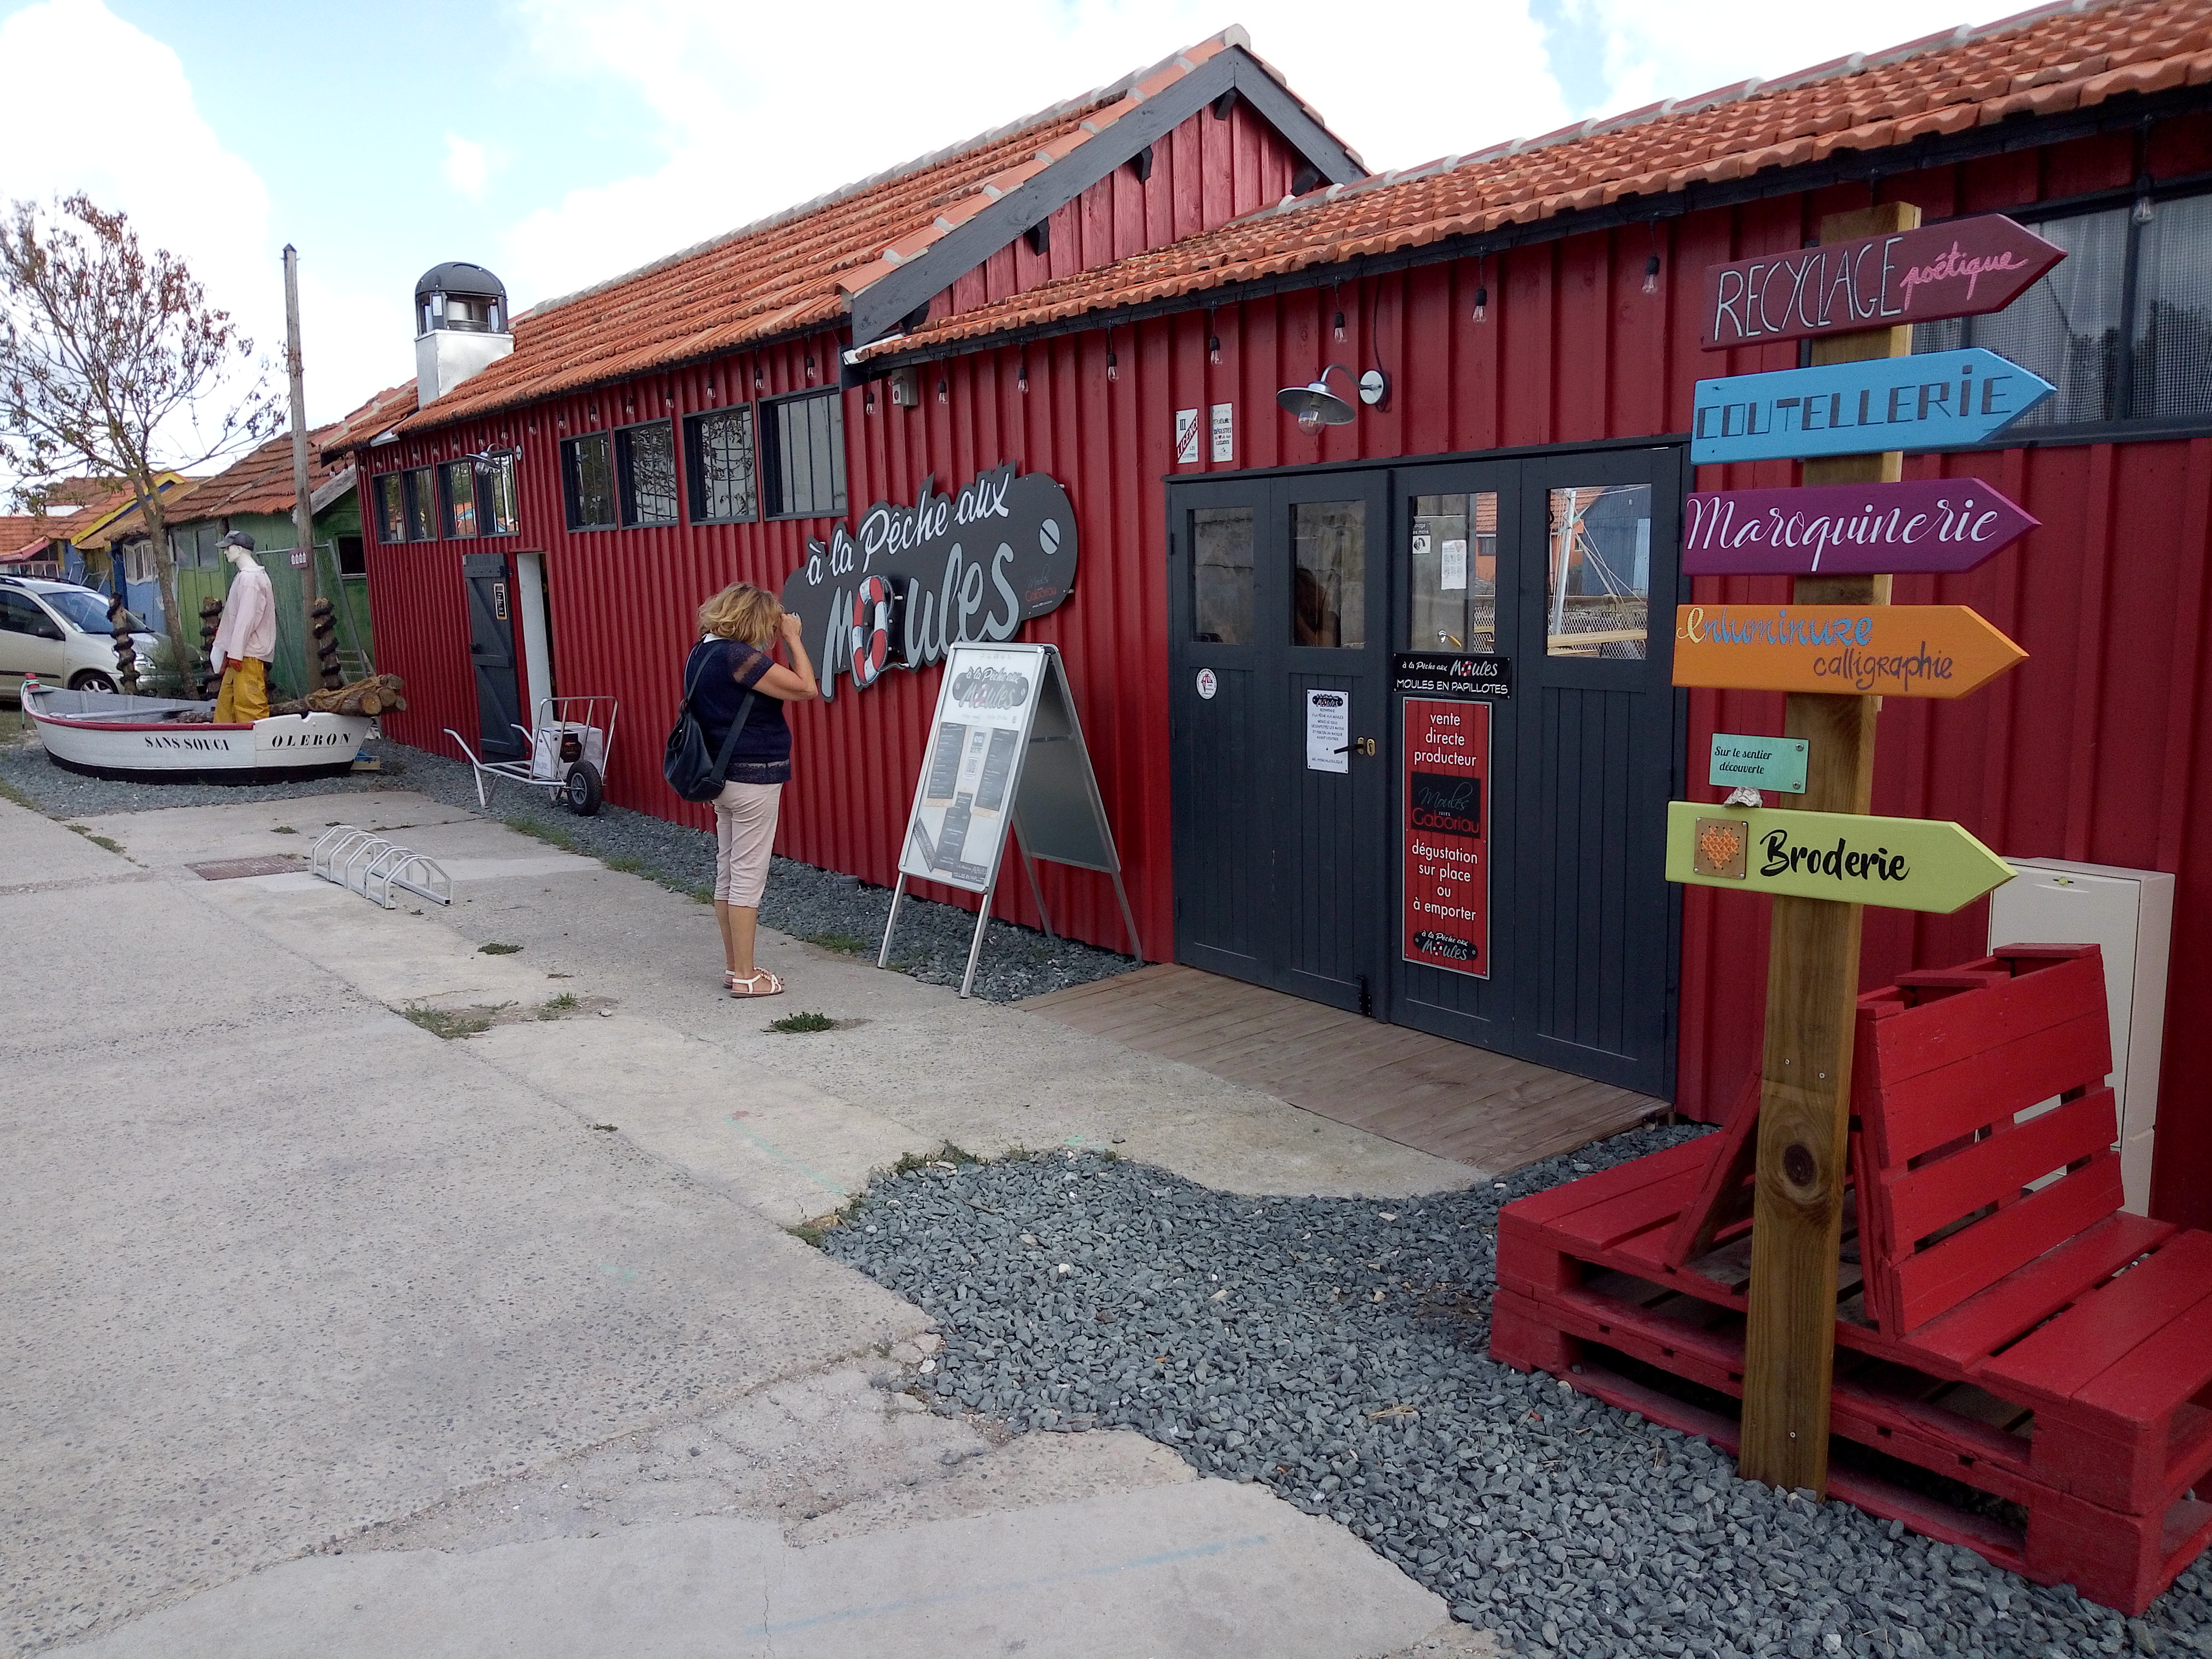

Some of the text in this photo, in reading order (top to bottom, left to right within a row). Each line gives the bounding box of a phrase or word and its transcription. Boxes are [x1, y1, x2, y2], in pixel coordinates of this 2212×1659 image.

[1714, 237, 2027, 341] RECYCLAGE poétique
[807, 473, 1010, 586] à la Pêche aux
[1686, 497, 1998, 572] Maroquinerie
[974, 667, 981, 680] la
[1814, 641, 1953, 691] calligraphie
[1397, 679, 1507, 694] MOULES EN PAPILLOTES
[1430, 713, 1461, 726] vente
[145, 736, 230, 751] SANS SOUCI
[272, 733, 351, 748] OLERON
[1426, 727, 1465, 746] directe
[1414, 747, 1477, 767] producteur
[1715, 746, 1772, 759] Sur le sentier
[1720, 762, 1764, 774] découverte
[1419, 782, 1472, 810] Moules
[1412, 839, 1477, 864] dégustation
[1759, 829, 1910, 881] Broderie
[1419, 862, 1470, 882] sur place
[1437, 886, 1451, 897] ou
[1413, 896, 1476, 920] à emporter
